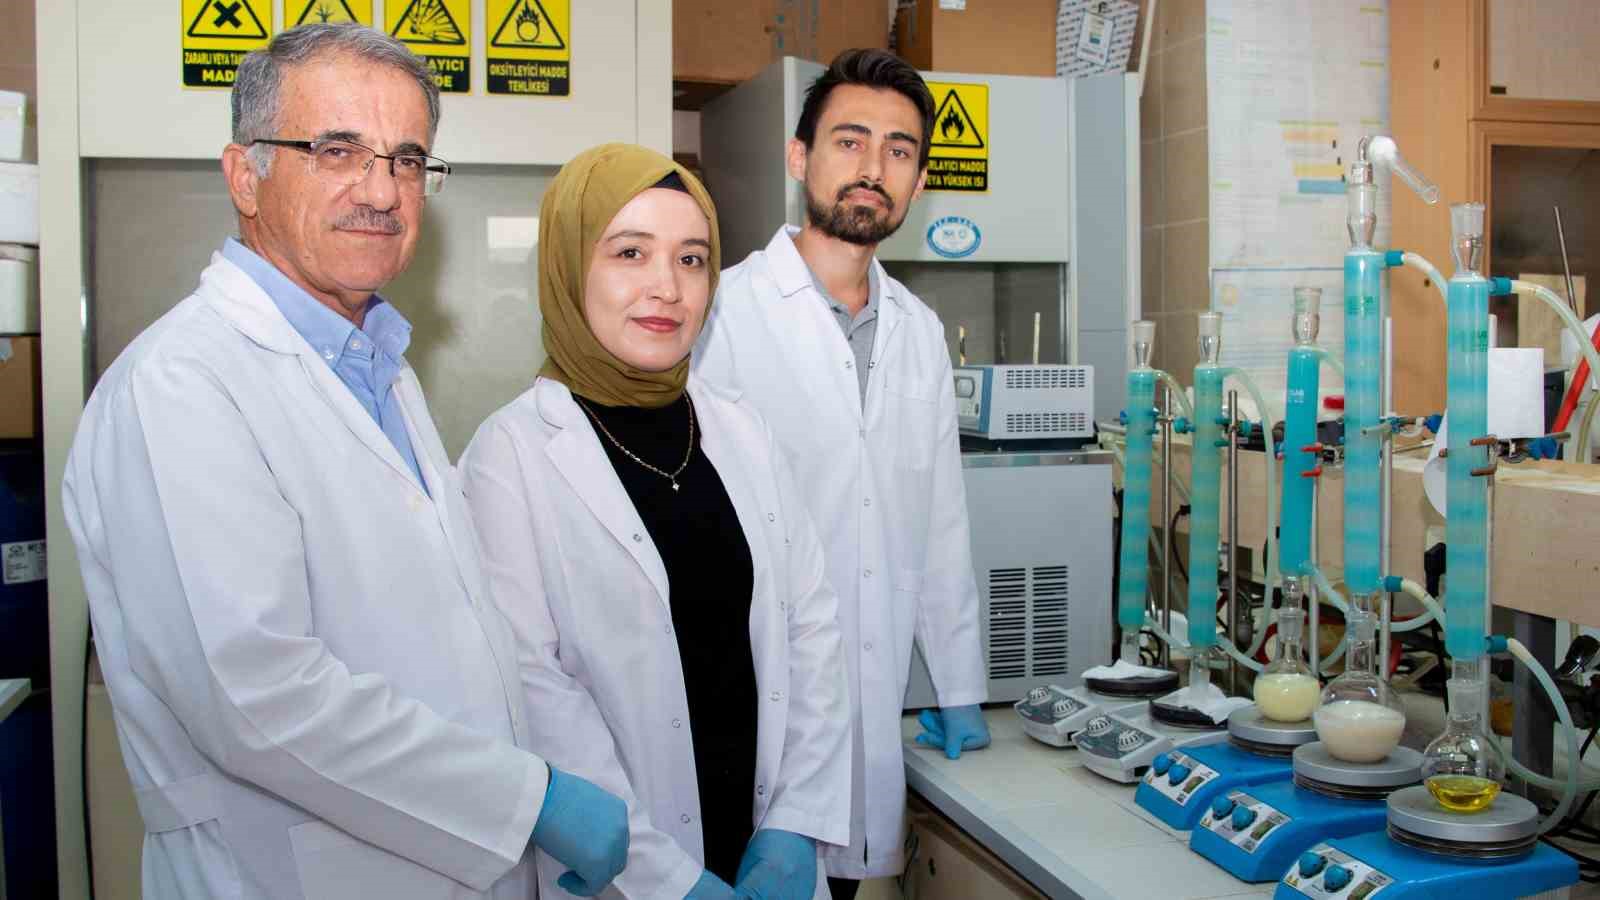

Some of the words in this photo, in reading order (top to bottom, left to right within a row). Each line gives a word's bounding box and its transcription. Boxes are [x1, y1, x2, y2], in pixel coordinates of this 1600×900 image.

[428, 58, 465, 72] AYICI
[539, 65, 568, 79] MADDE
[959, 161, 986, 173] MADDE
[927, 174, 942, 186] EYA
